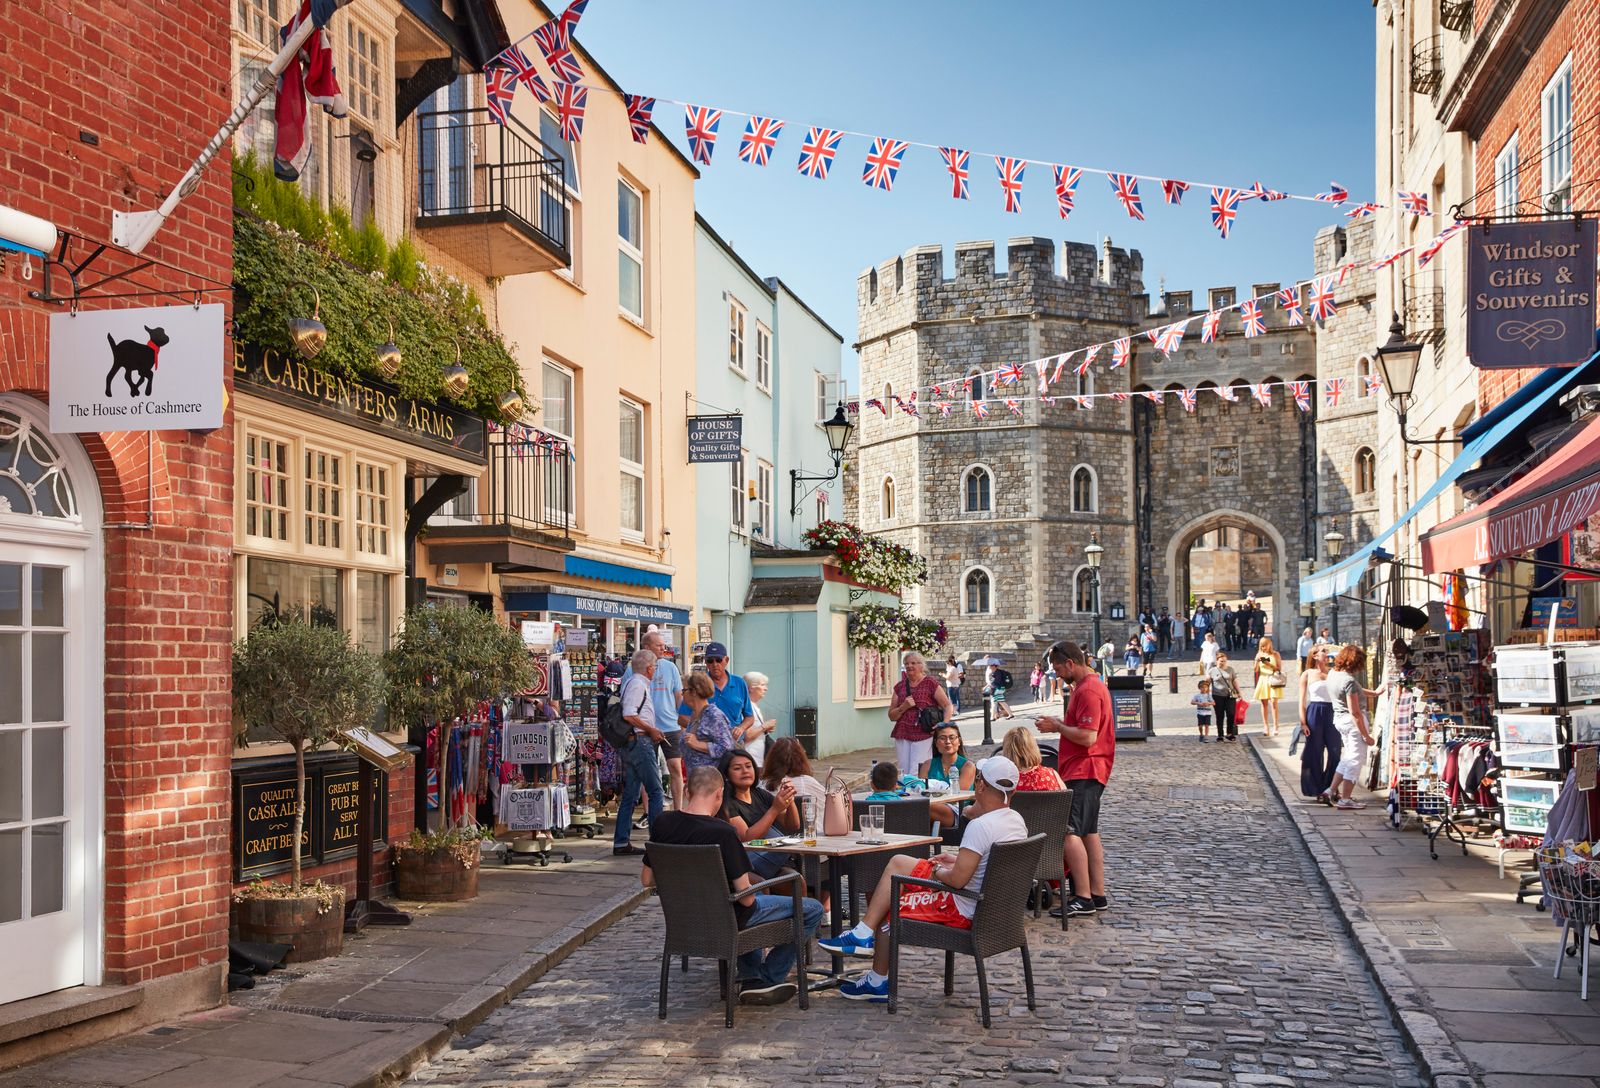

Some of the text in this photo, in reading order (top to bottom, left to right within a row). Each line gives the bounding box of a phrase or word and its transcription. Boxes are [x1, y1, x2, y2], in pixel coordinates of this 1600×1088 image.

[1482, 240, 1581, 261] Windsor
[1489, 266, 1574, 287] Gifts &
[1476, 289, 1590, 311] Souvenirs
[263, 349, 398, 422] CARPENTERS
[408, 400, 454, 441] ARMS
[68, 401, 202, 417] The House of Cashmere
[697, 421, 733, 430] HOUSE
[690, 431, 739, 441] OF GIFTS
[690, 443, 740, 453] Quality Gifts
[699, 452, 739, 460] Souvenirs
[1489, 503, 1546, 557] SOUVENIRS
[1546, 498, 1559, 539] &
[576, 597, 595, 611] HOUSE
[595, 600, 603, 612] OF
[603, 601, 618, 614] GIFTS
[623, 603, 639, 618] Quality
[640, 605, 650, 617] Gifts
[654, 608, 673, 620] Souvenirs
[512, 733, 548, 746] WINDSOR
[260, 788, 296, 803] QUALITY
[328, 783, 351, 795] GREAT
[510, 790, 543, 803] Oxford
[331, 795, 349, 811] PUB
[248, 802, 278, 822] CASK
[340, 810, 359, 823] SERV
[333, 824, 351, 841] ALL
[246, 830, 309, 855] CRAFT BES
